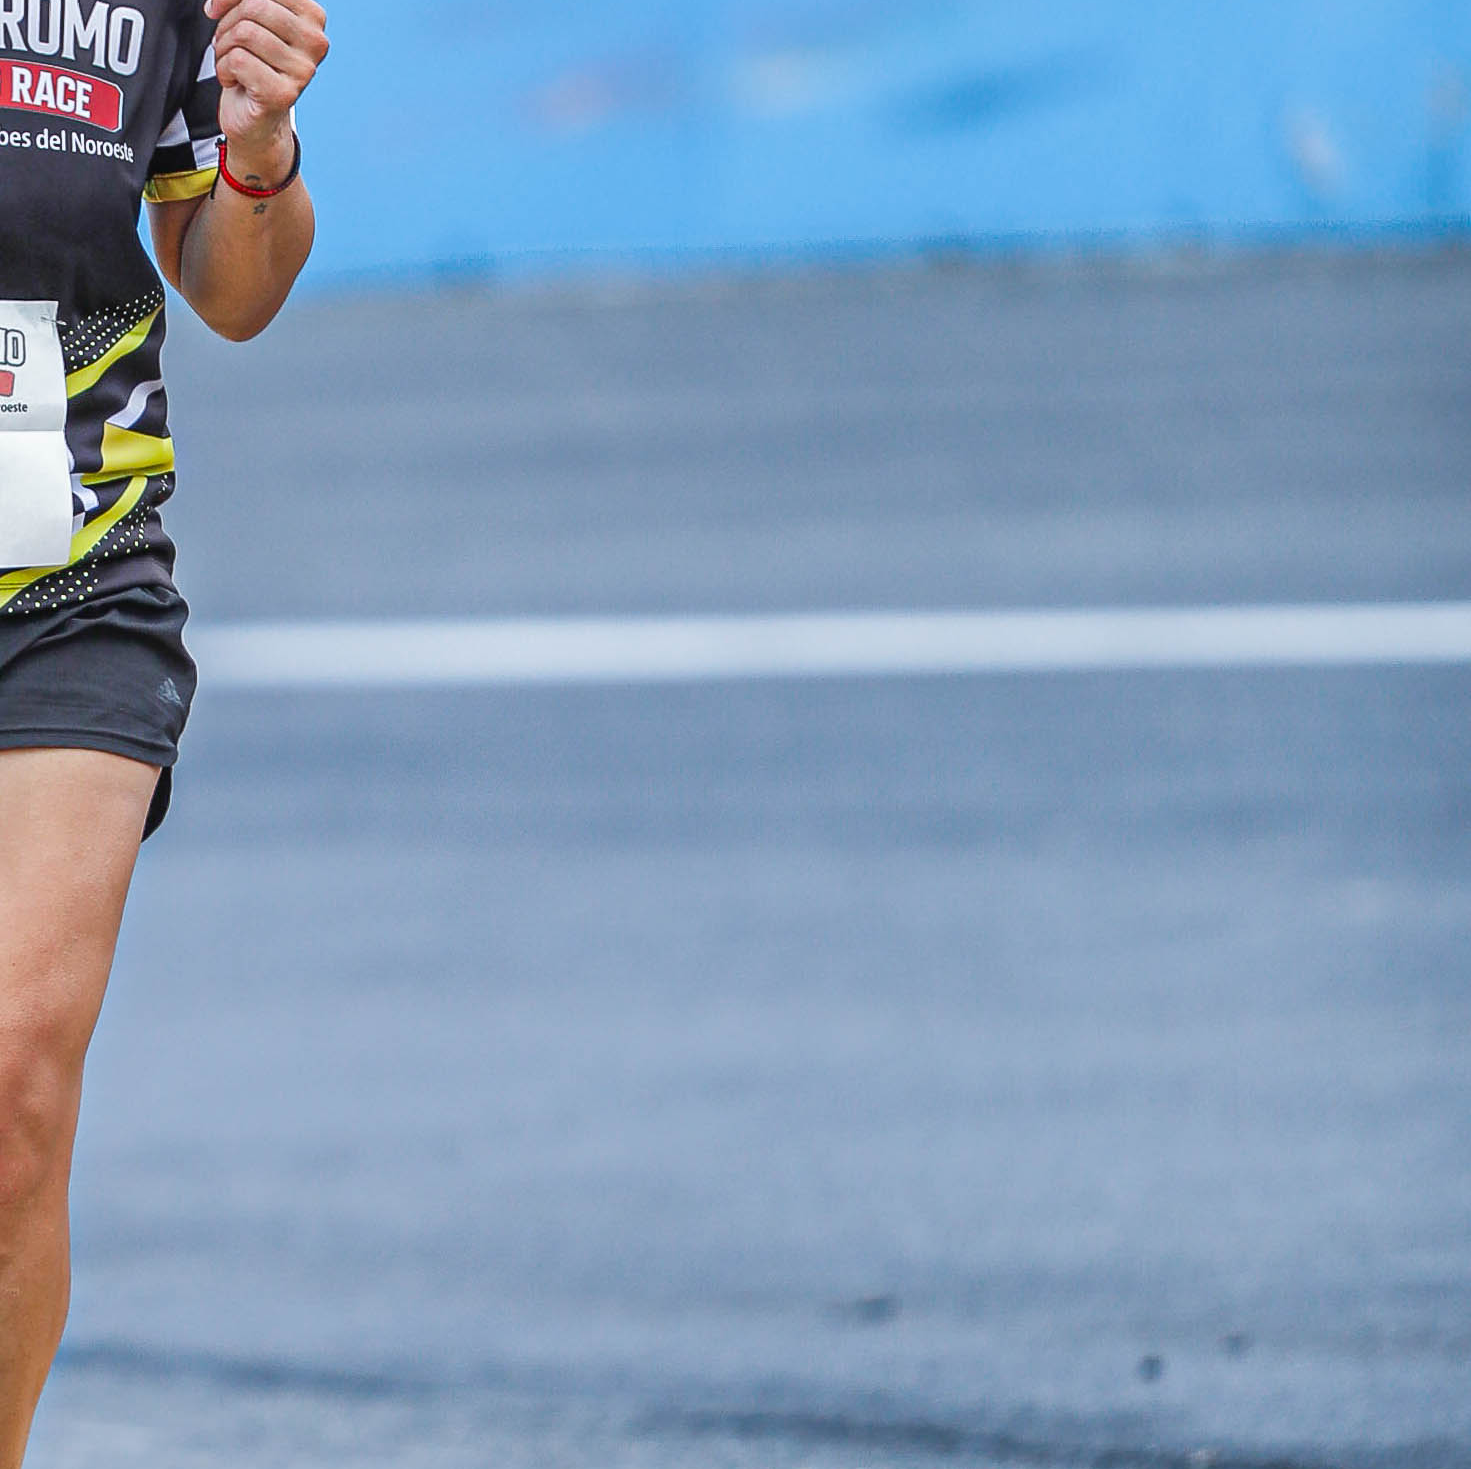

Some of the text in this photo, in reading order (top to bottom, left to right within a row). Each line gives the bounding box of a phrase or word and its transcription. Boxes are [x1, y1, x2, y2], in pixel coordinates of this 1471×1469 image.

[11, 66, 93, 120] RACE
[35, 127, 67, 152] del
[71, 131, 134, 163] Noroeste
